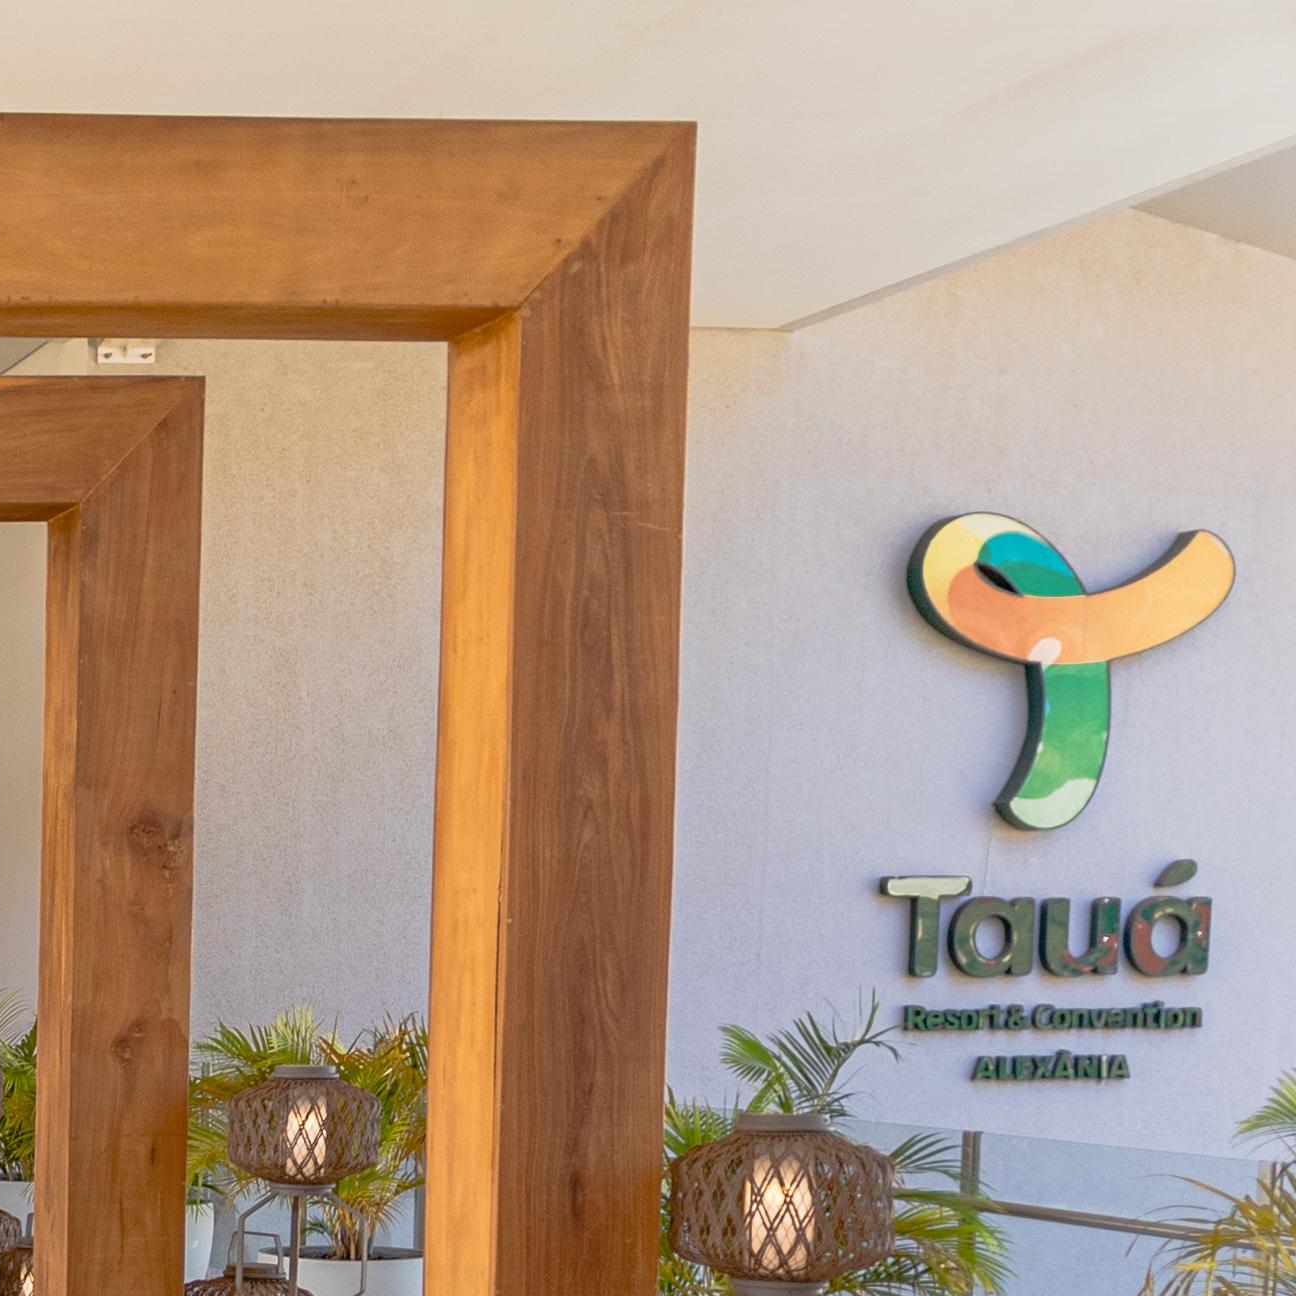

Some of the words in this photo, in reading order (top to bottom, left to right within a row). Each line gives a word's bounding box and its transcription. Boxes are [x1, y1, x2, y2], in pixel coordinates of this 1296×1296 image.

[880, 858, 1212, 978] Tauá
[903, 1003, 1002, 1031] Resort
[1006, 1003, 1030, 1031] &
[1032, 1000, 1203, 1030] Convention
[970, 1049, 1130, 1081] ALEXÂNIA
